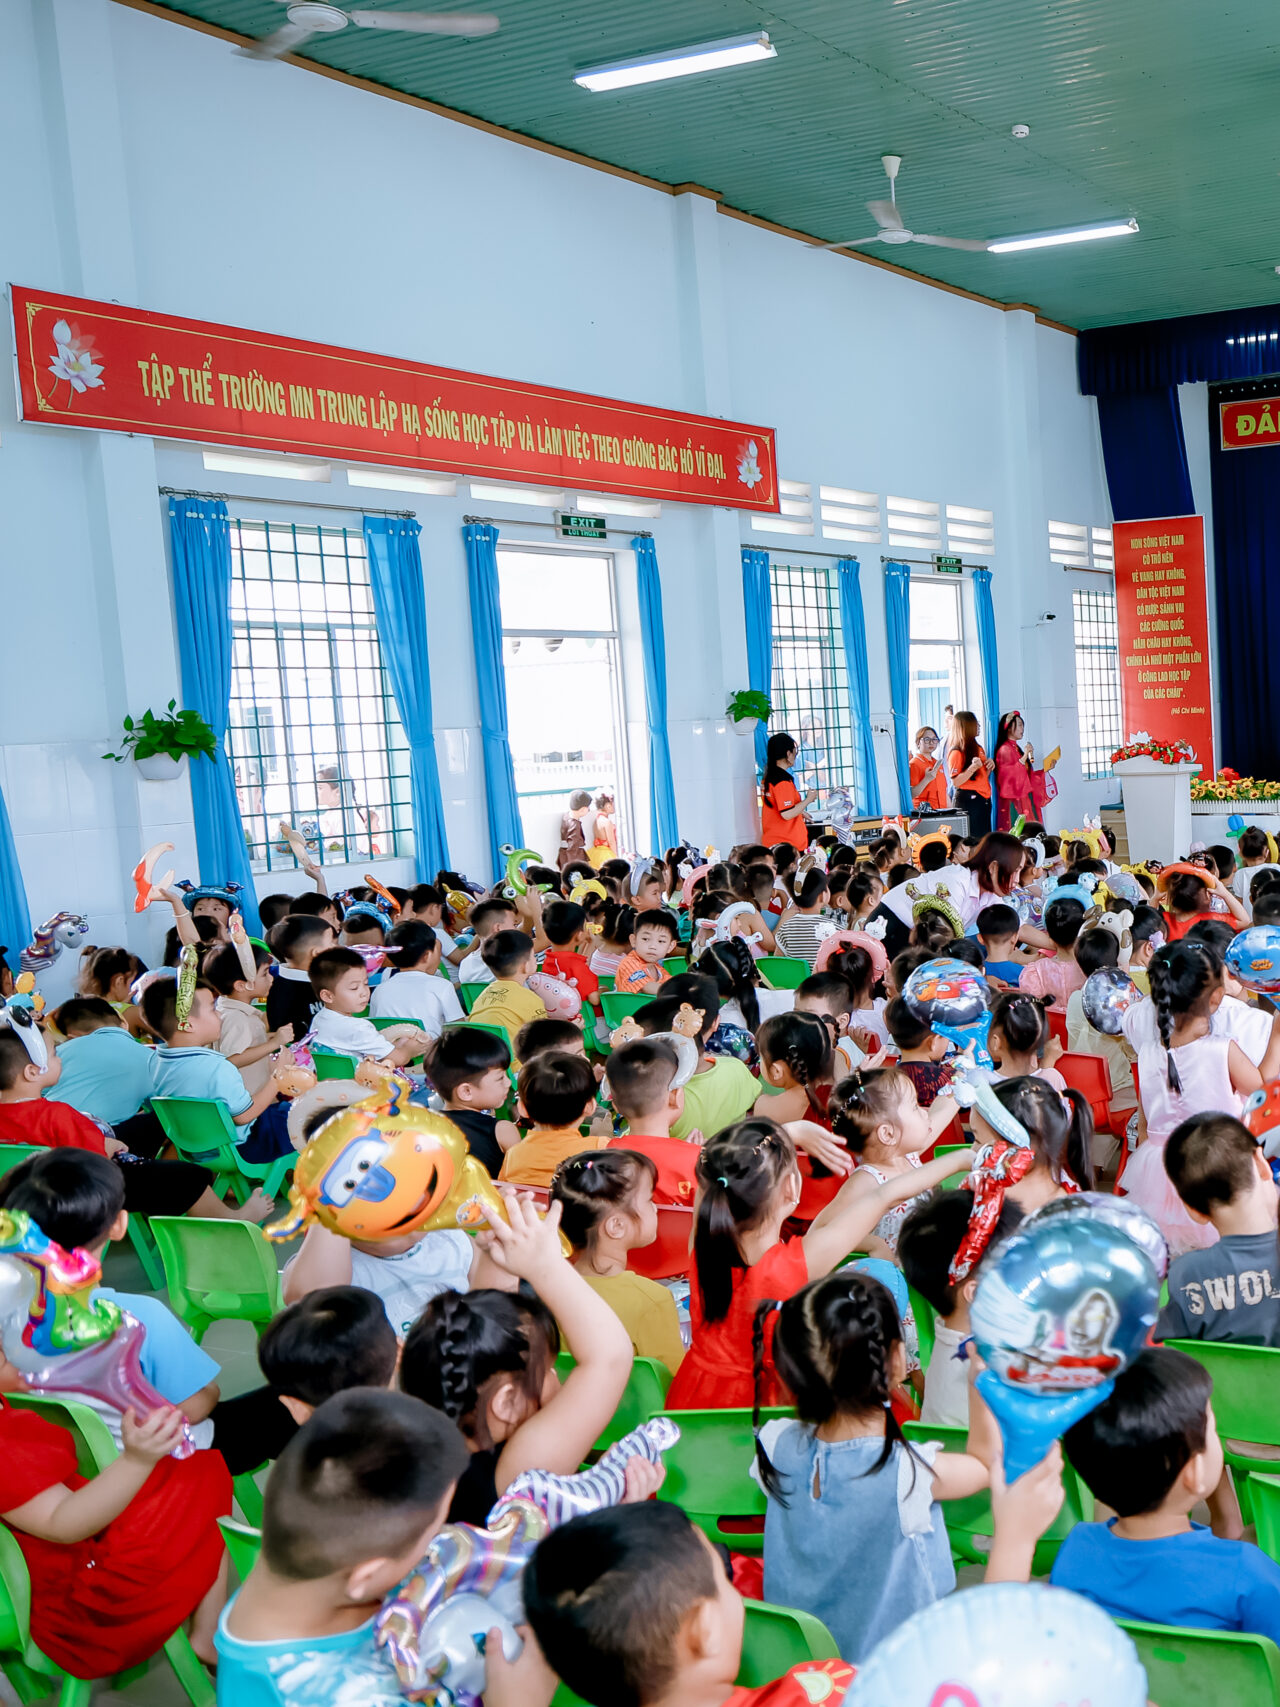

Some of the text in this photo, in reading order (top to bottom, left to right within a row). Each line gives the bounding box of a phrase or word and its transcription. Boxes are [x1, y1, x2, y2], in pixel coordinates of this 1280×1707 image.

[138, 353, 175, 406] TẬP
[178, 353, 215, 406] THỂ
[218, 370, 285, 417] TRƯỜNG
[289, 385, 314, 420] MN
[317, 390, 367, 428] TRUNG
[370, 391, 398, 436] LẬP
[401, 402, 421, 437] HẠ
[424, 396, 460, 441] SỐNG
[463, 413, 489, 450] HỌC
[491, 410, 515, 454] TẬP
[518, 415, 534, 452] VÀ
[538, 418, 562, 456] LÀM
[564, 424, 590, 465] VIỆC
[592, 434, 620, 464] THEO
[623, 436, 656, 470] GƯƠNG
[658, 439, 679, 472] BÁC
[680, 438, 694, 475] HỒ
[696, 445, 706, 477] VĨ
[570, 517, 596, 527] EXIT
